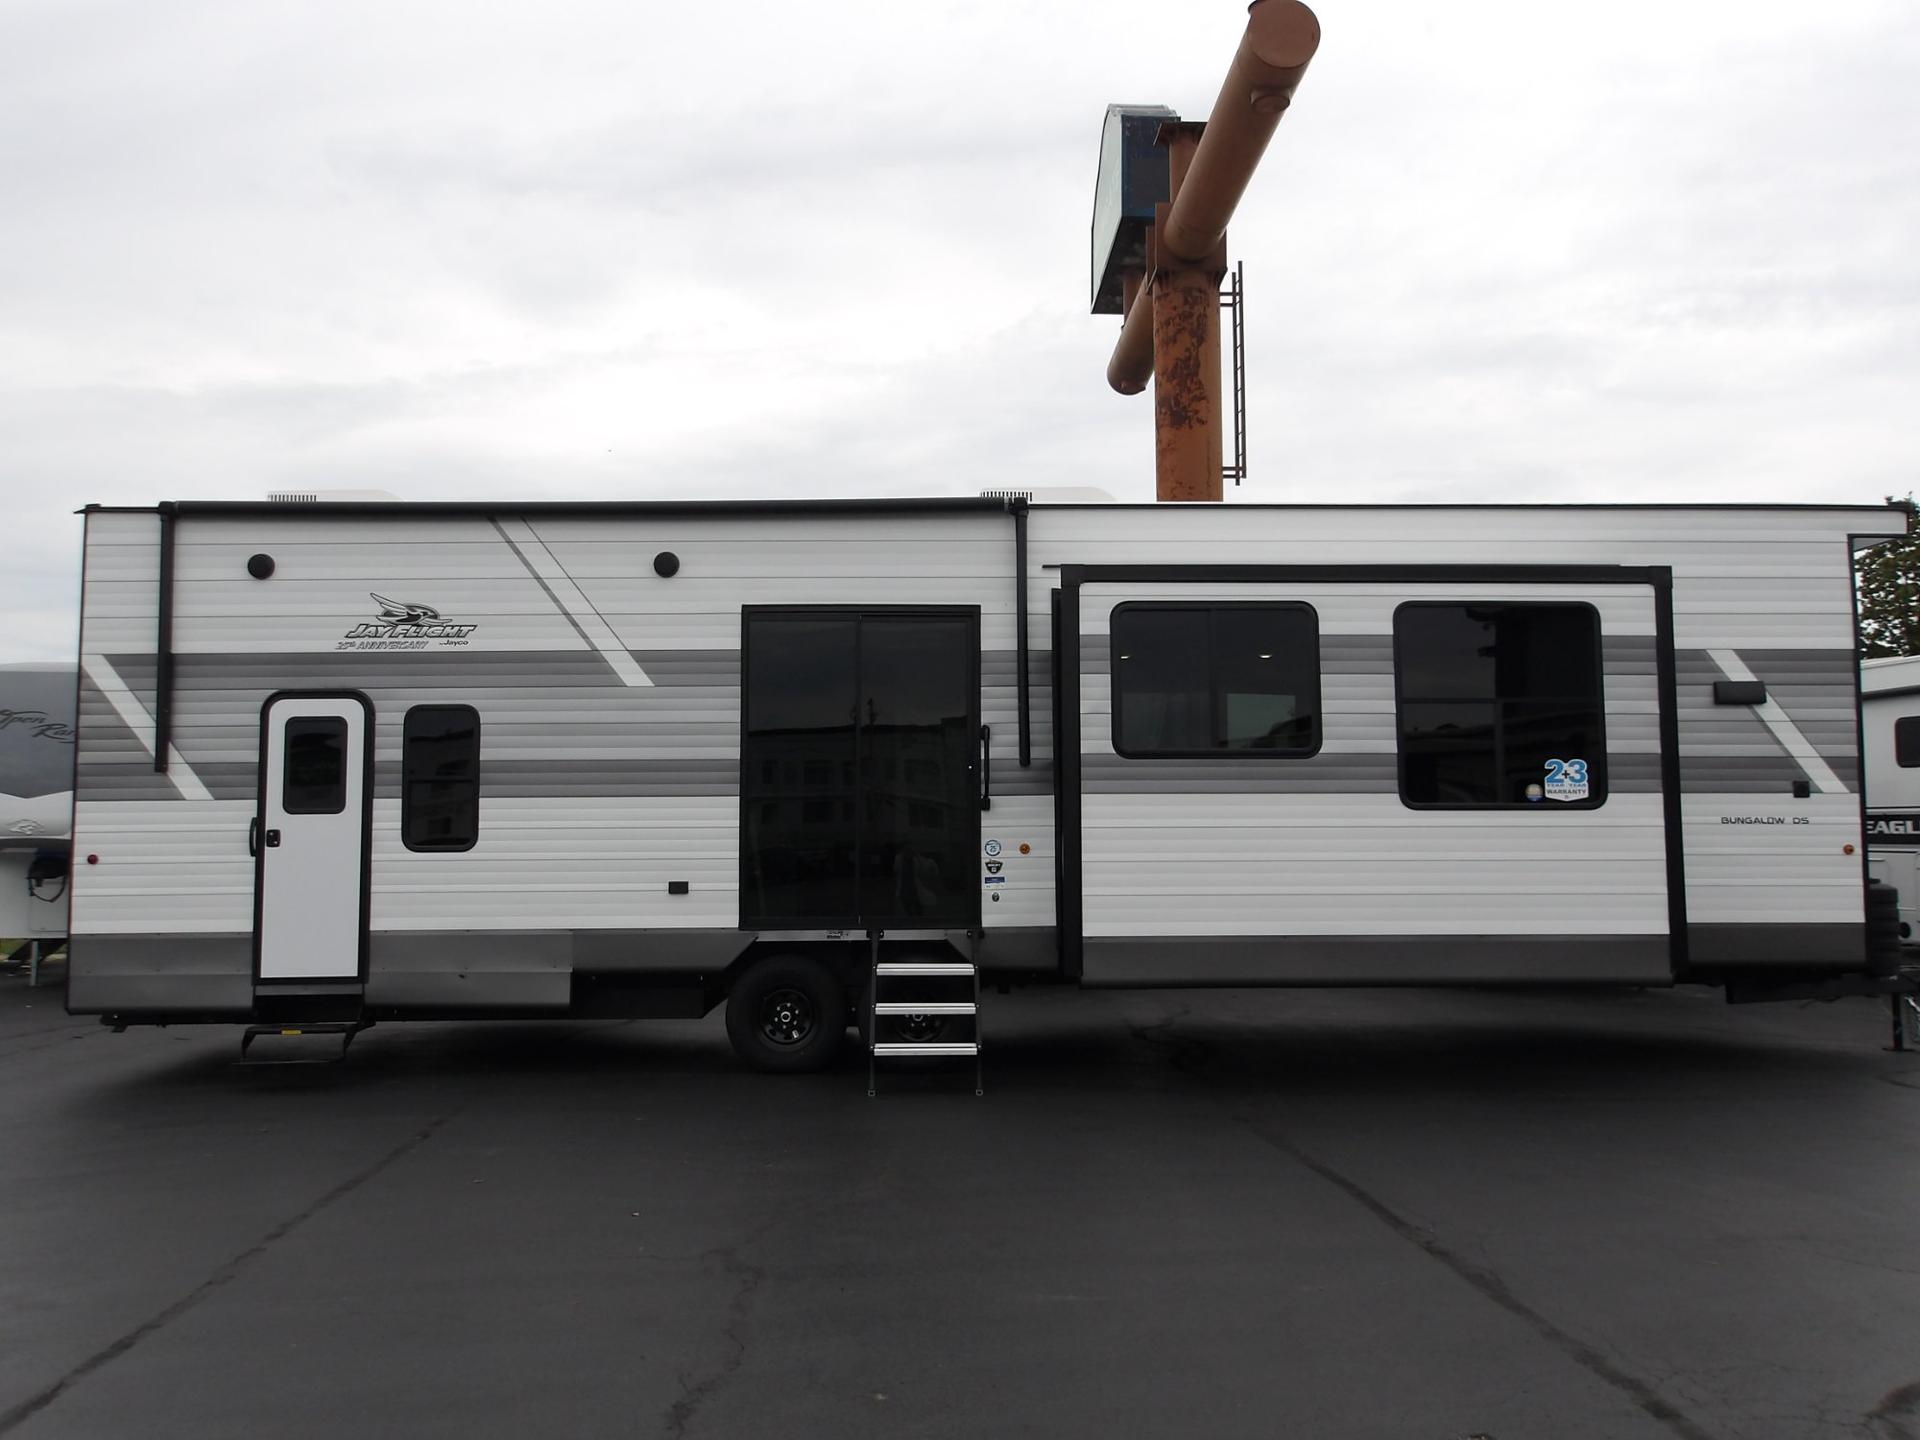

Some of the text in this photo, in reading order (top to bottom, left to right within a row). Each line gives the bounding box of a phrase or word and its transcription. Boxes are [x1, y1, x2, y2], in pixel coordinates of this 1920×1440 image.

[344, 623, 478, 638] JAY FLIGHT
[1721, 816, 1810, 825] BUNGALOW DS
